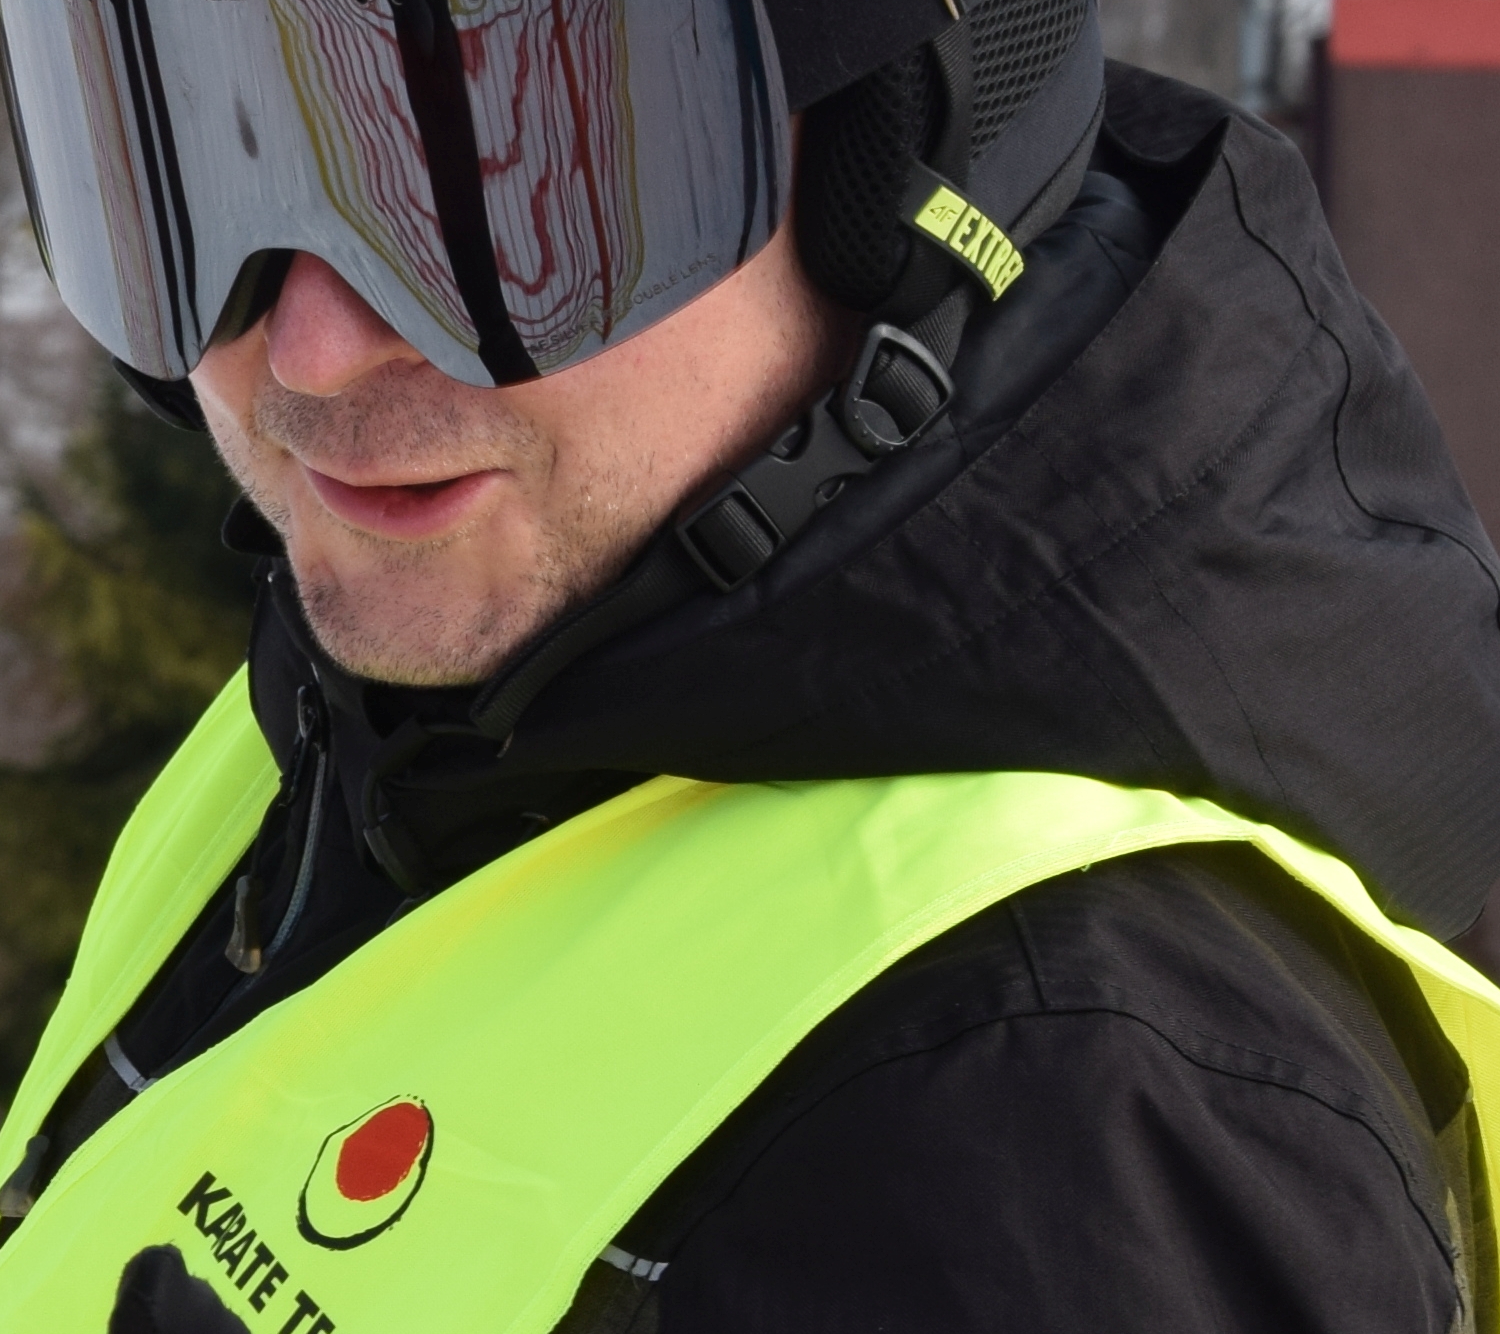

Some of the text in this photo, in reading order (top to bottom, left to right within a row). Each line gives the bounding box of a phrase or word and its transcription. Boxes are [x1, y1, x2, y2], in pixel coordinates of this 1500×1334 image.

[624, 273, 679, 309] DOUBLE
[681, 252, 717, 280] LENS
[177, 1170, 289, 1314] KARATE
